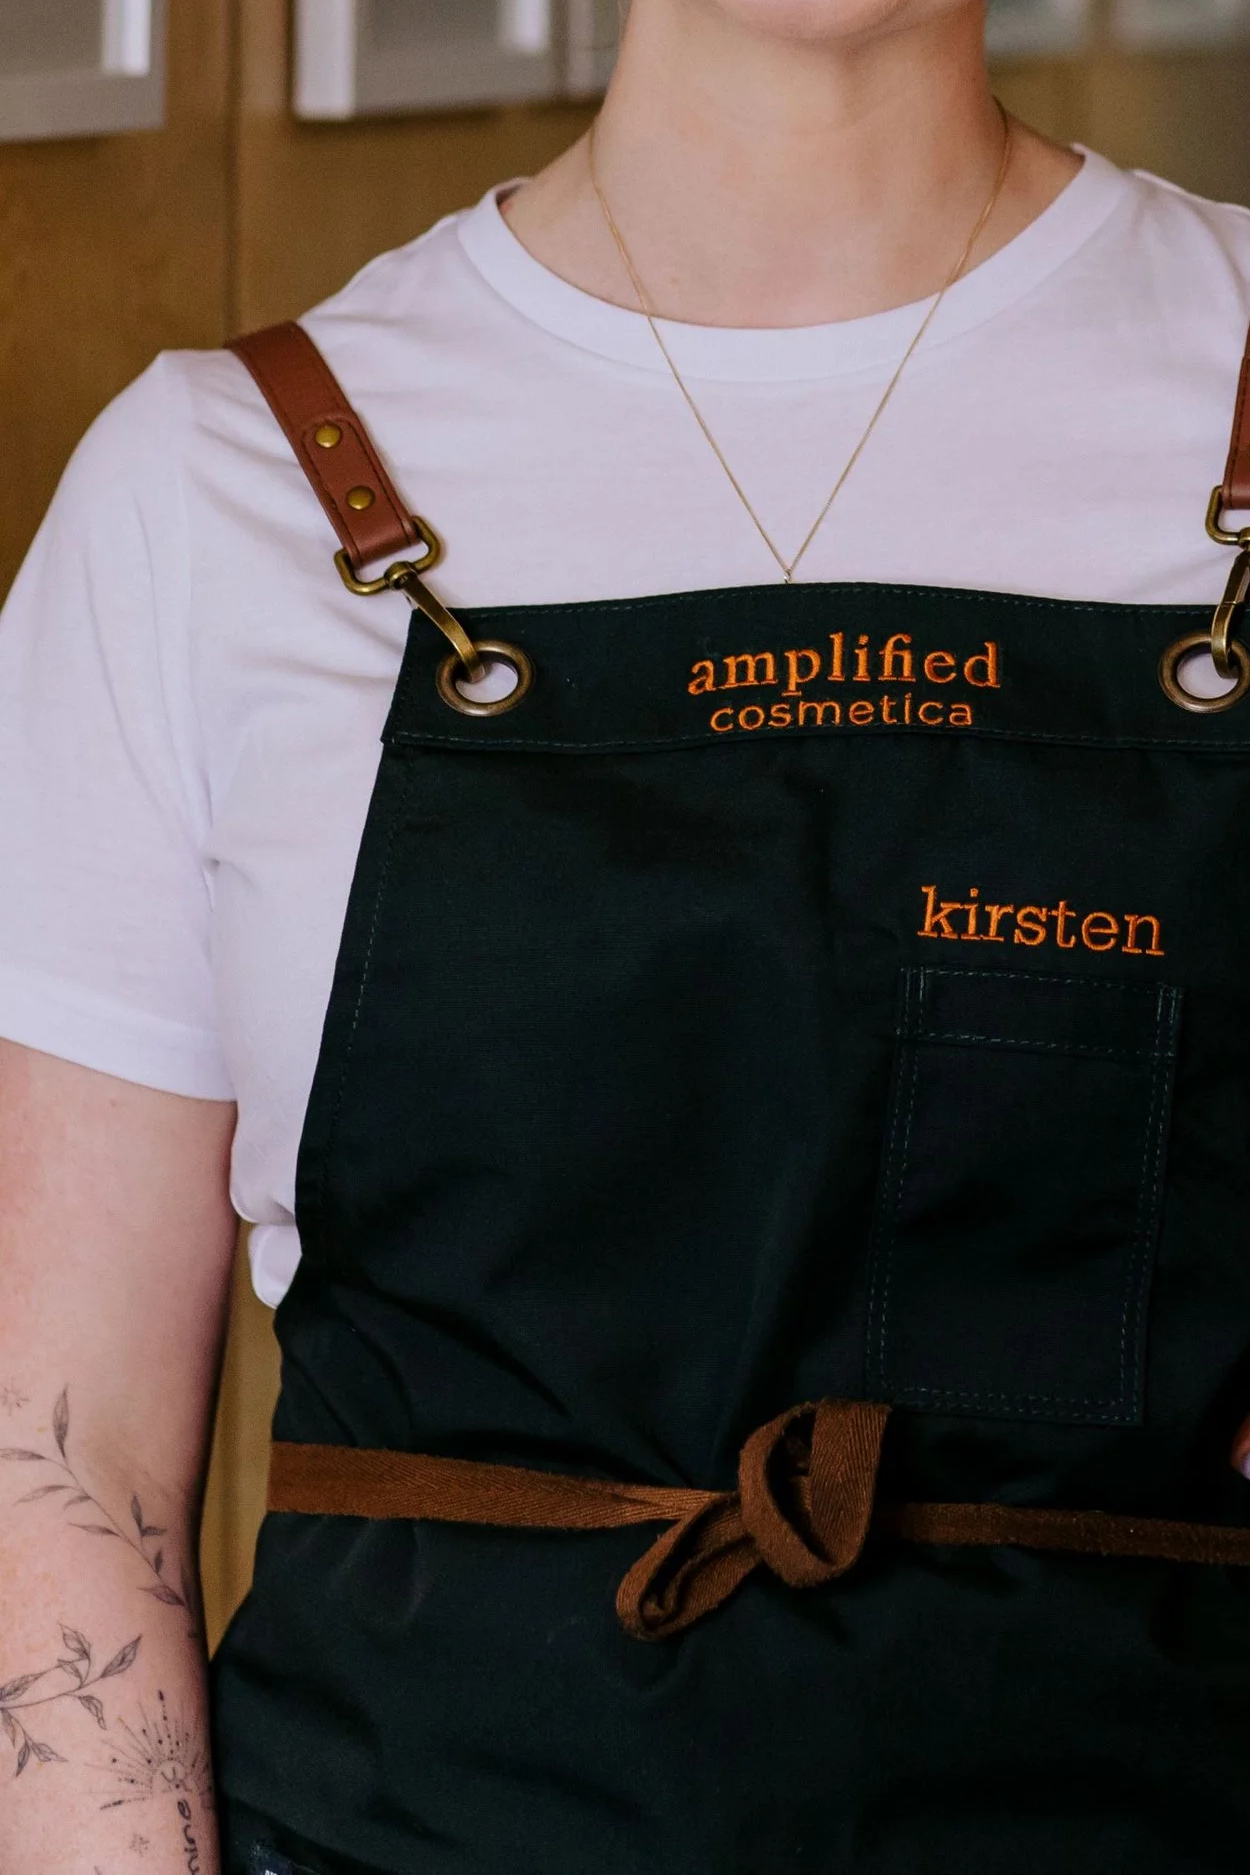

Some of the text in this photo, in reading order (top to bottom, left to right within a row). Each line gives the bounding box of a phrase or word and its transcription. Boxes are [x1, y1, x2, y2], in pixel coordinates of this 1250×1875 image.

[687, 631, 1001, 697] amplified
[709, 692, 974, 732] cosmetica
[916, 885, 1165, 956] kirsten
